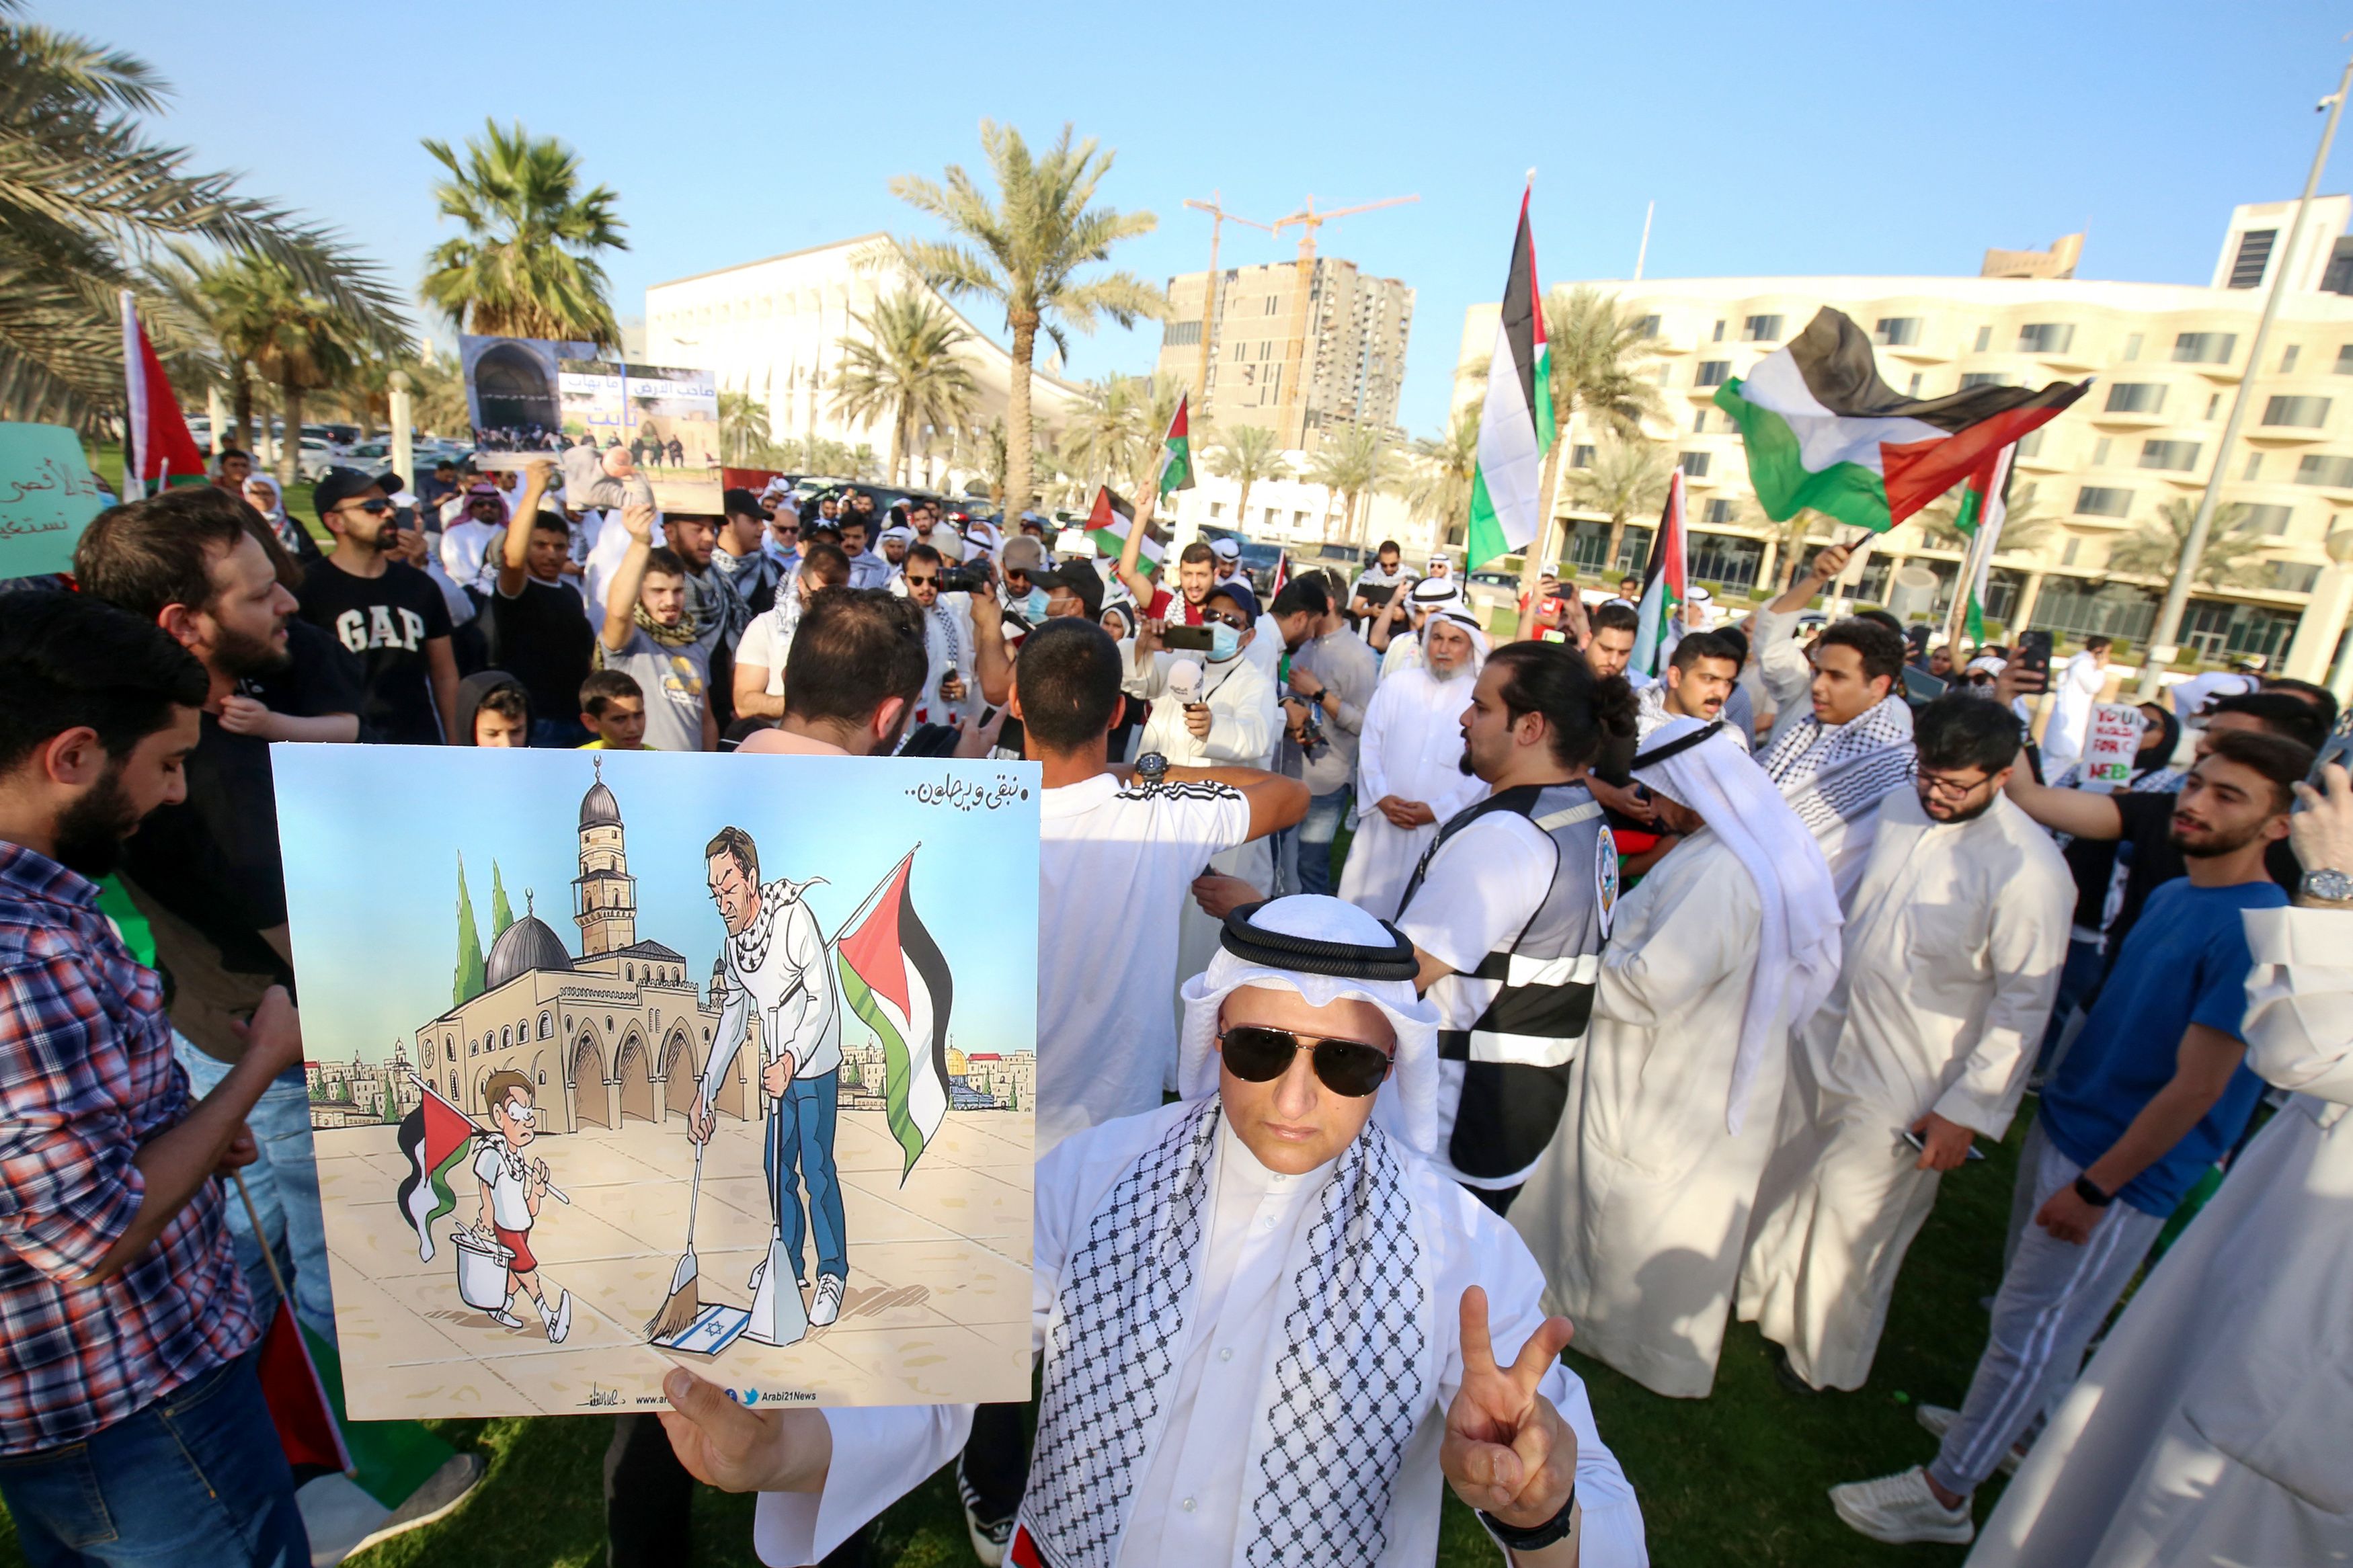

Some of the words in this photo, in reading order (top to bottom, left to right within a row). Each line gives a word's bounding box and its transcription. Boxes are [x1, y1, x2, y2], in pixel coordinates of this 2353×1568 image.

[336, 605, 425, 653] GAP
[986, 774, 1019, 809] نبقى
[762, 1391, 817, 1402] Arabi21News
